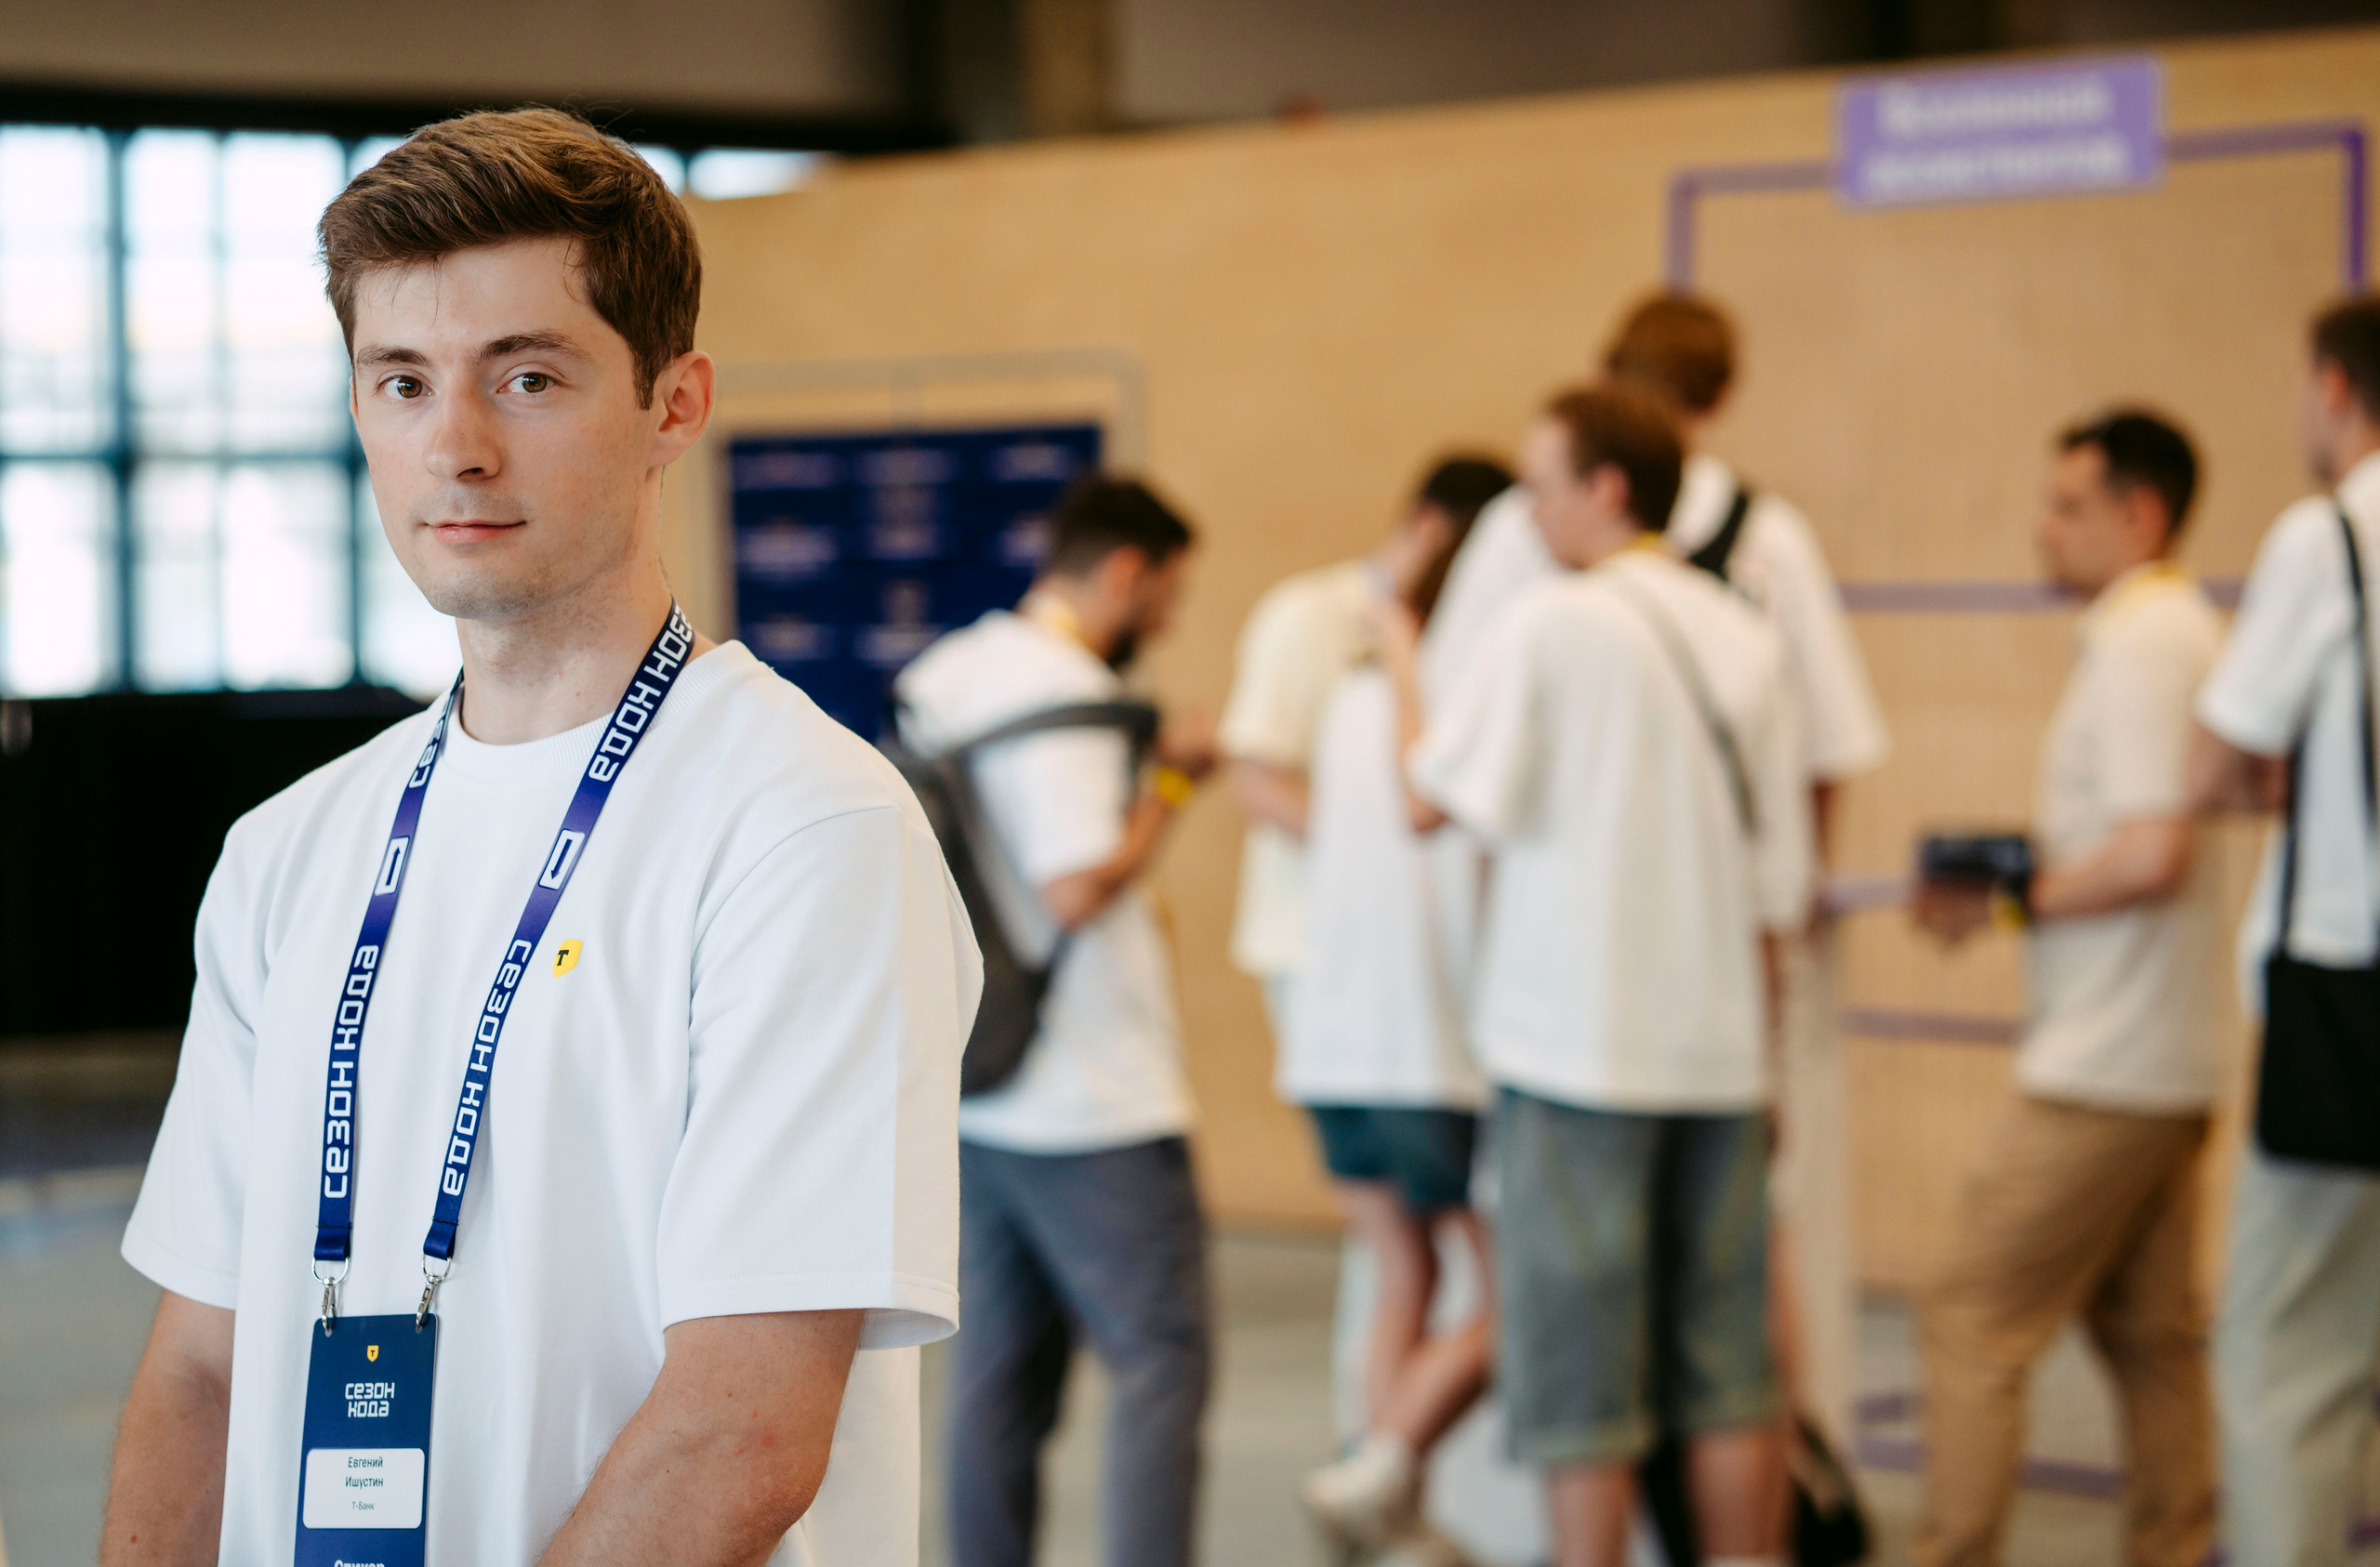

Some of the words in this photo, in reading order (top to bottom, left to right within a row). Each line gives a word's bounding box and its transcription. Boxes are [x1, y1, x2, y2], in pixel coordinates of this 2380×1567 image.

[348, 1455, 383, 1468] Евгений
[345, 1476, 384, 1490] Ишустин
[351, 1501, 375, 1510] Т-Банк
